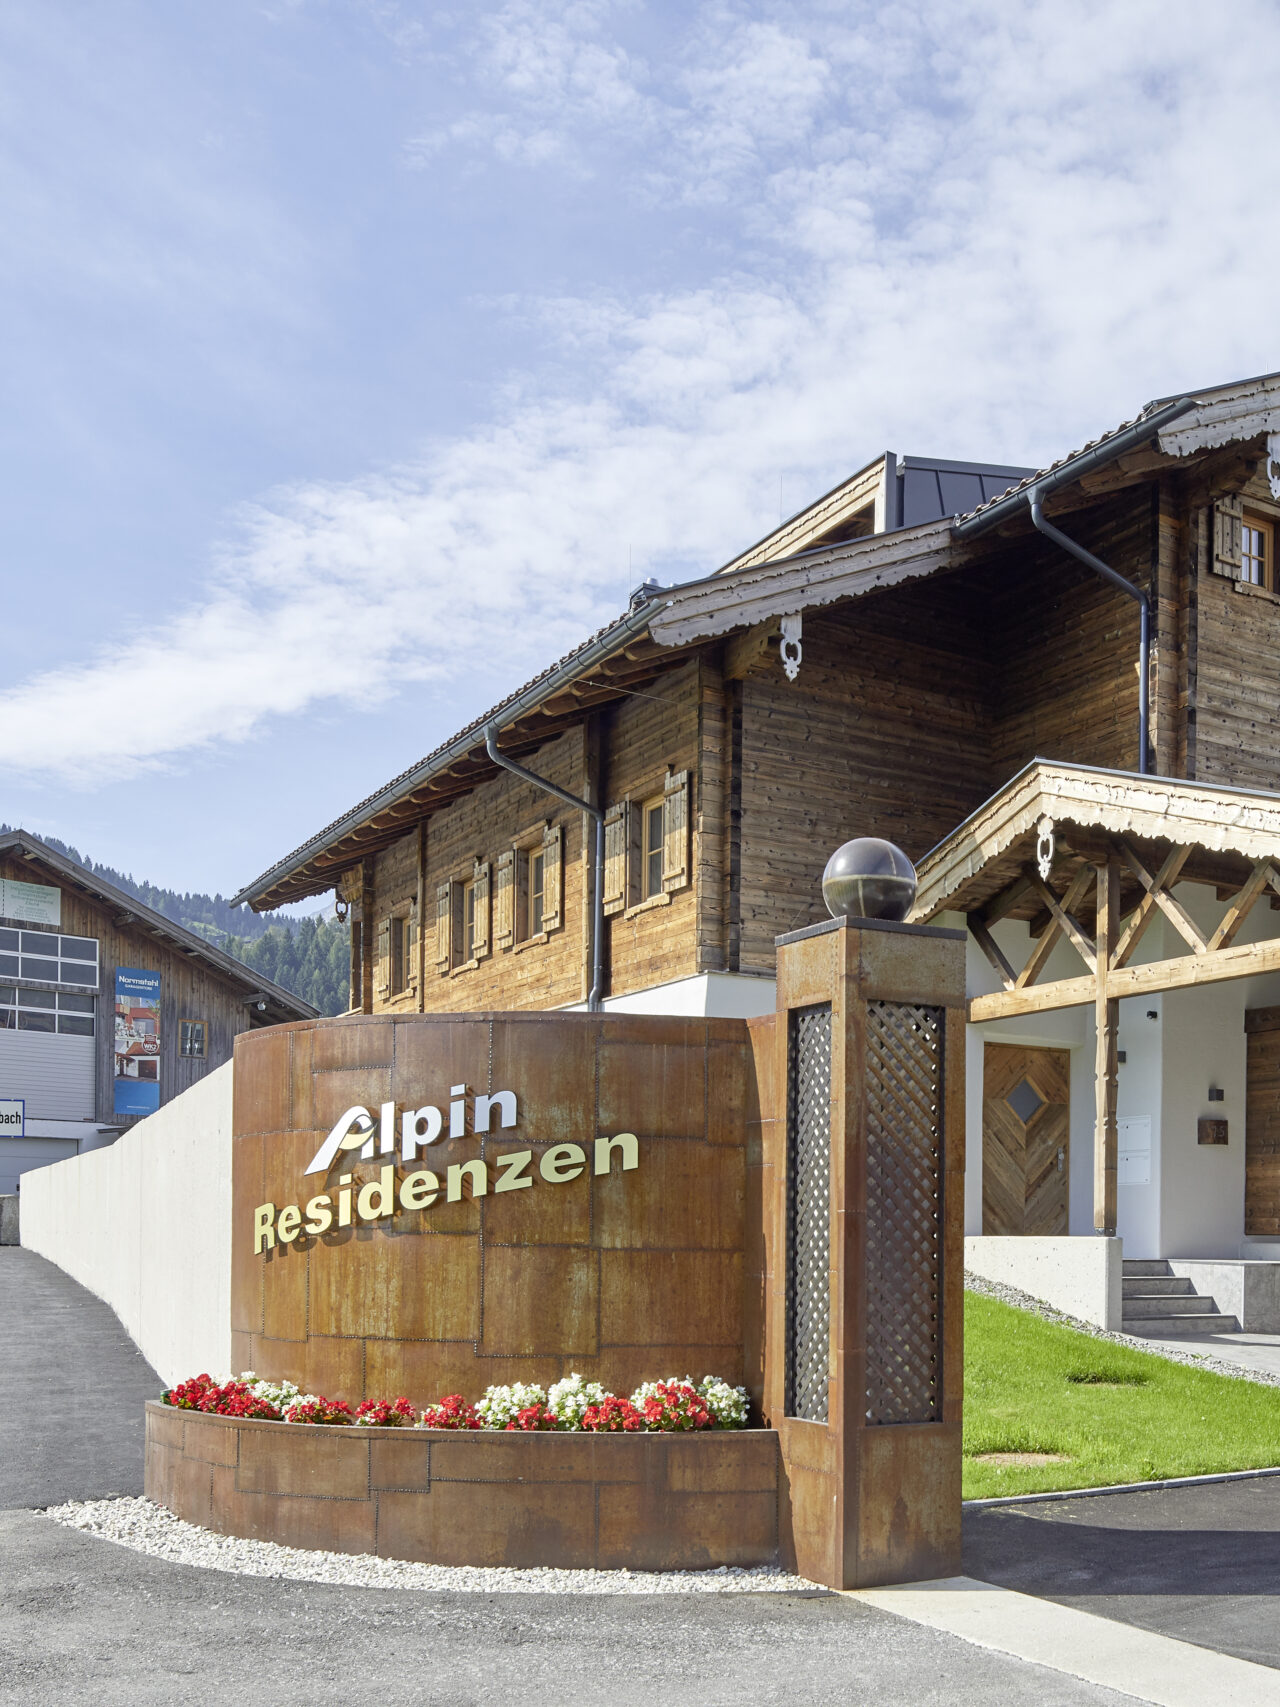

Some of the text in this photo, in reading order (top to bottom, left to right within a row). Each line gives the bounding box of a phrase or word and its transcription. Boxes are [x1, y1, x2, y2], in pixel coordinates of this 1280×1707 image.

[118, 975, 159, 987] Normstahl
[303, 1083, 518, 1176] Alpin
[253, 1132, 640, 1256] Residenzen
